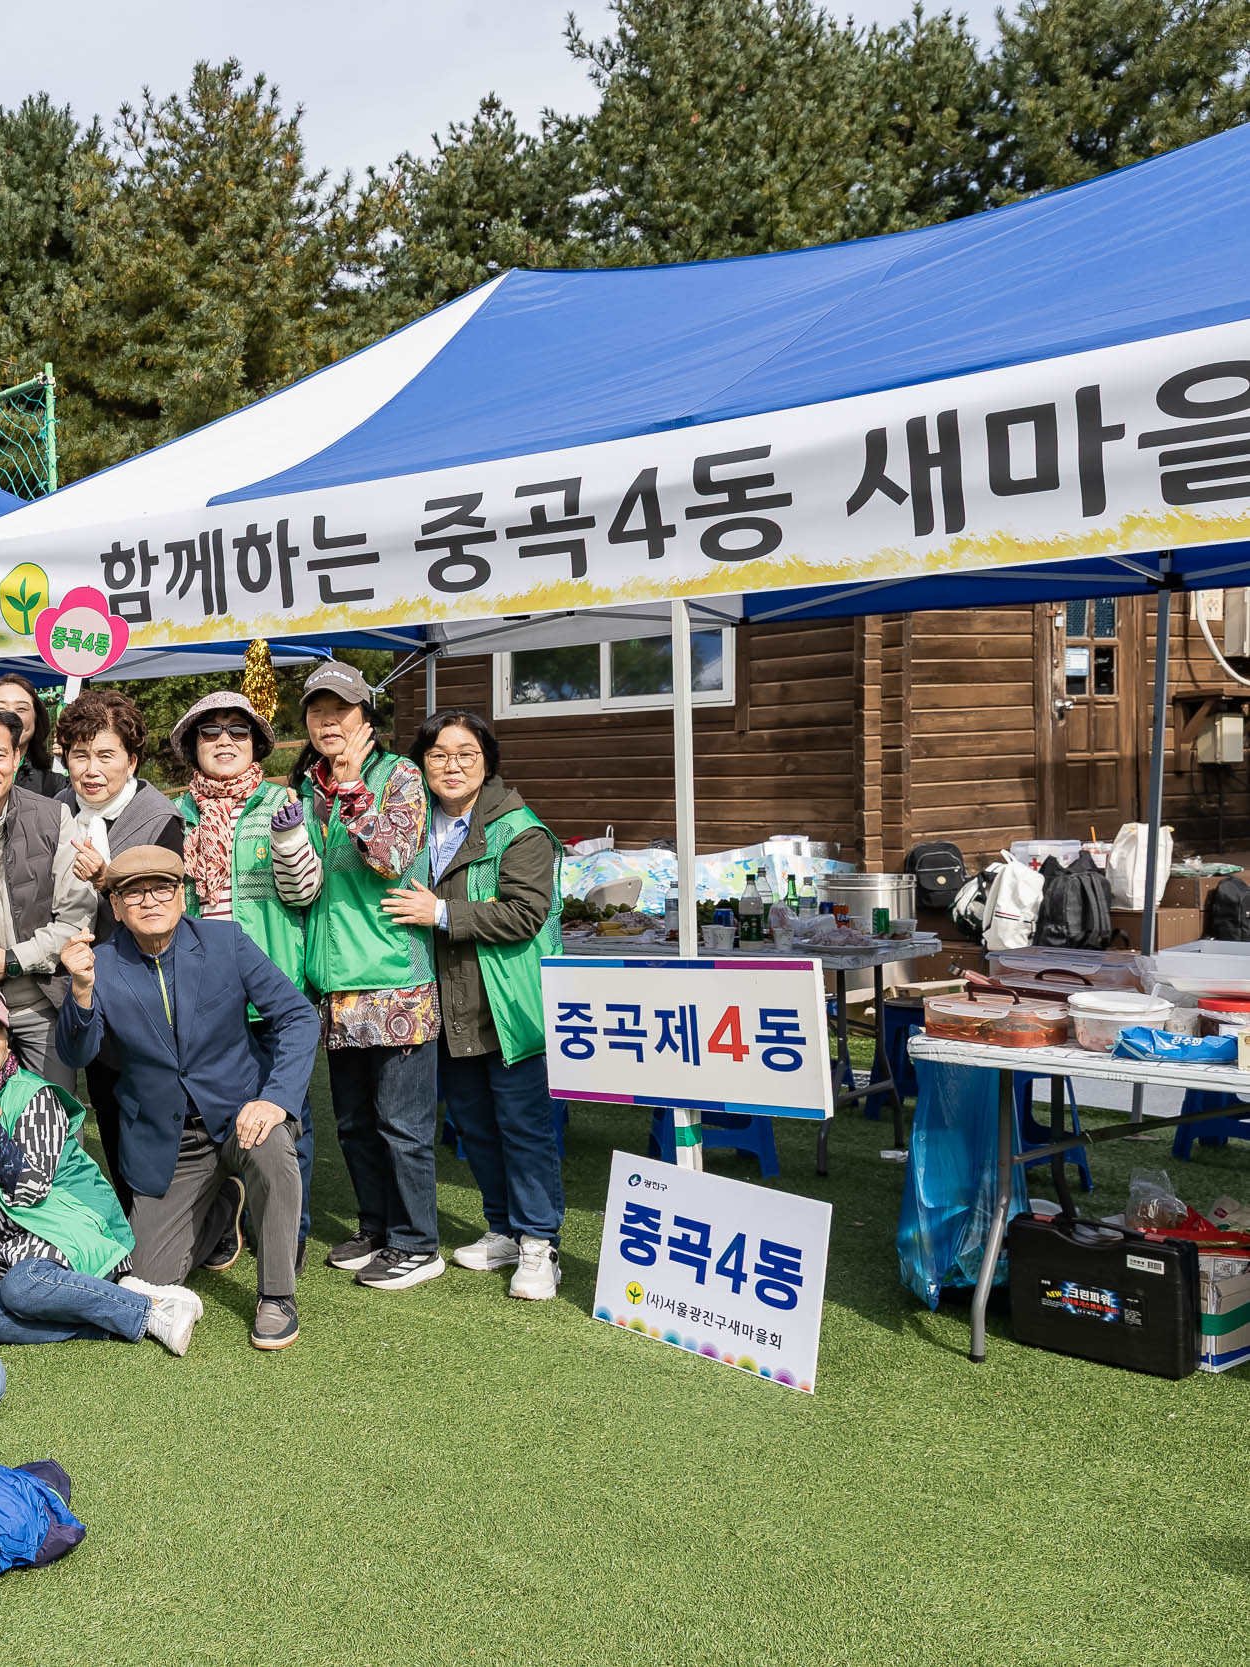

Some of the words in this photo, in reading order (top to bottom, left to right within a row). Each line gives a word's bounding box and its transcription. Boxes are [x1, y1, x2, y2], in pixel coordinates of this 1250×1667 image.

[100, 514, 380, 624] 함께하는
[414, 443, 792, 593] 중곡4동
[847, 359, 1250, 537] 새마을
[51, 626, 110, 656] 중곡4동
[554, 1002, 807, 1072] 중곡제4동
[643, 1179, 668, 1192] 광진구
[619, 1201, 803, 1311] 중곡4동
[1045, 1290, 1063, 1298] NEW
[1068, 1287, 1112, 1307] 크린파워
[645, 1291, 783, 1350] (사)서울광진구새마을회
